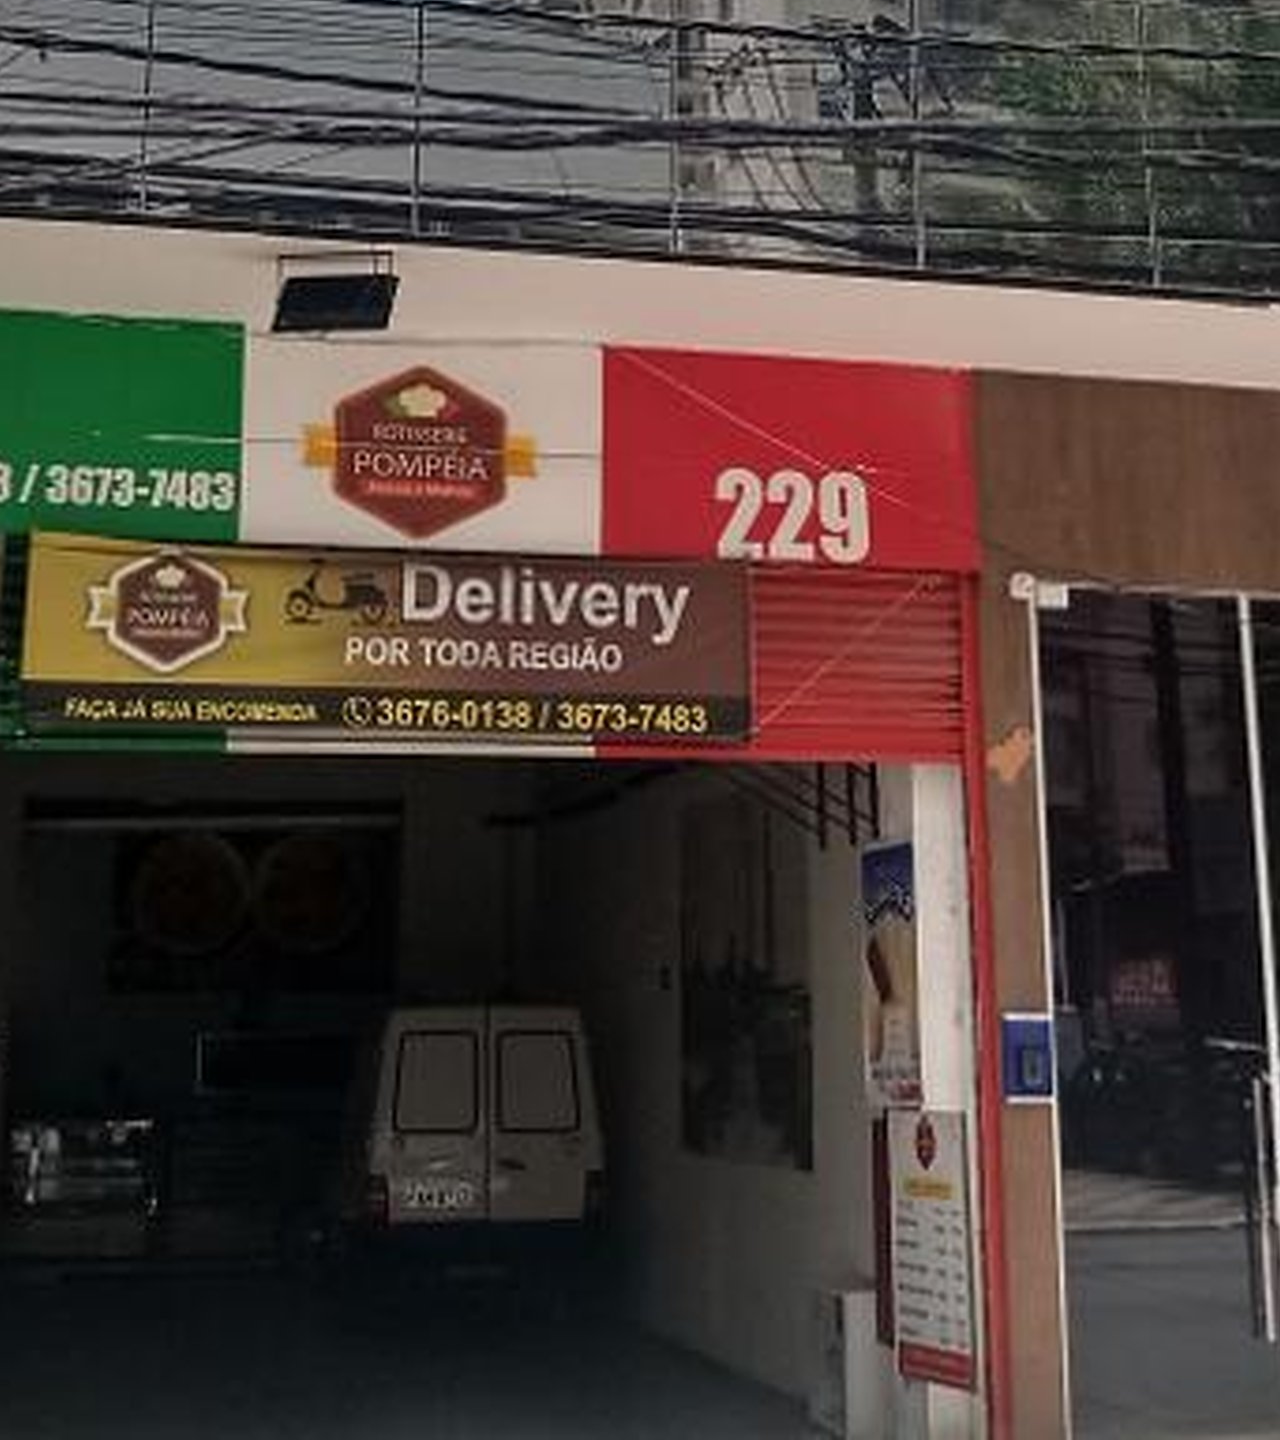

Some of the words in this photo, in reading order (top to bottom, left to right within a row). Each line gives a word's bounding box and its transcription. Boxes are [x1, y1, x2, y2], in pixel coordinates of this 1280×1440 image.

[20, 463, 38, 504] /
[45, 464, 235, 512] 3673-7483
[716, 468, 870, 564] 229
[403, 563, 690, 644] Delivery
[345, 636, 411, 666] POR
[418, 638, 503, 669] TODA
[508, 636, 623, 672] REGIÃO
[376, 695, 532, 728] 3676-0138
[556, 702, 709, 733] 3673-7483
